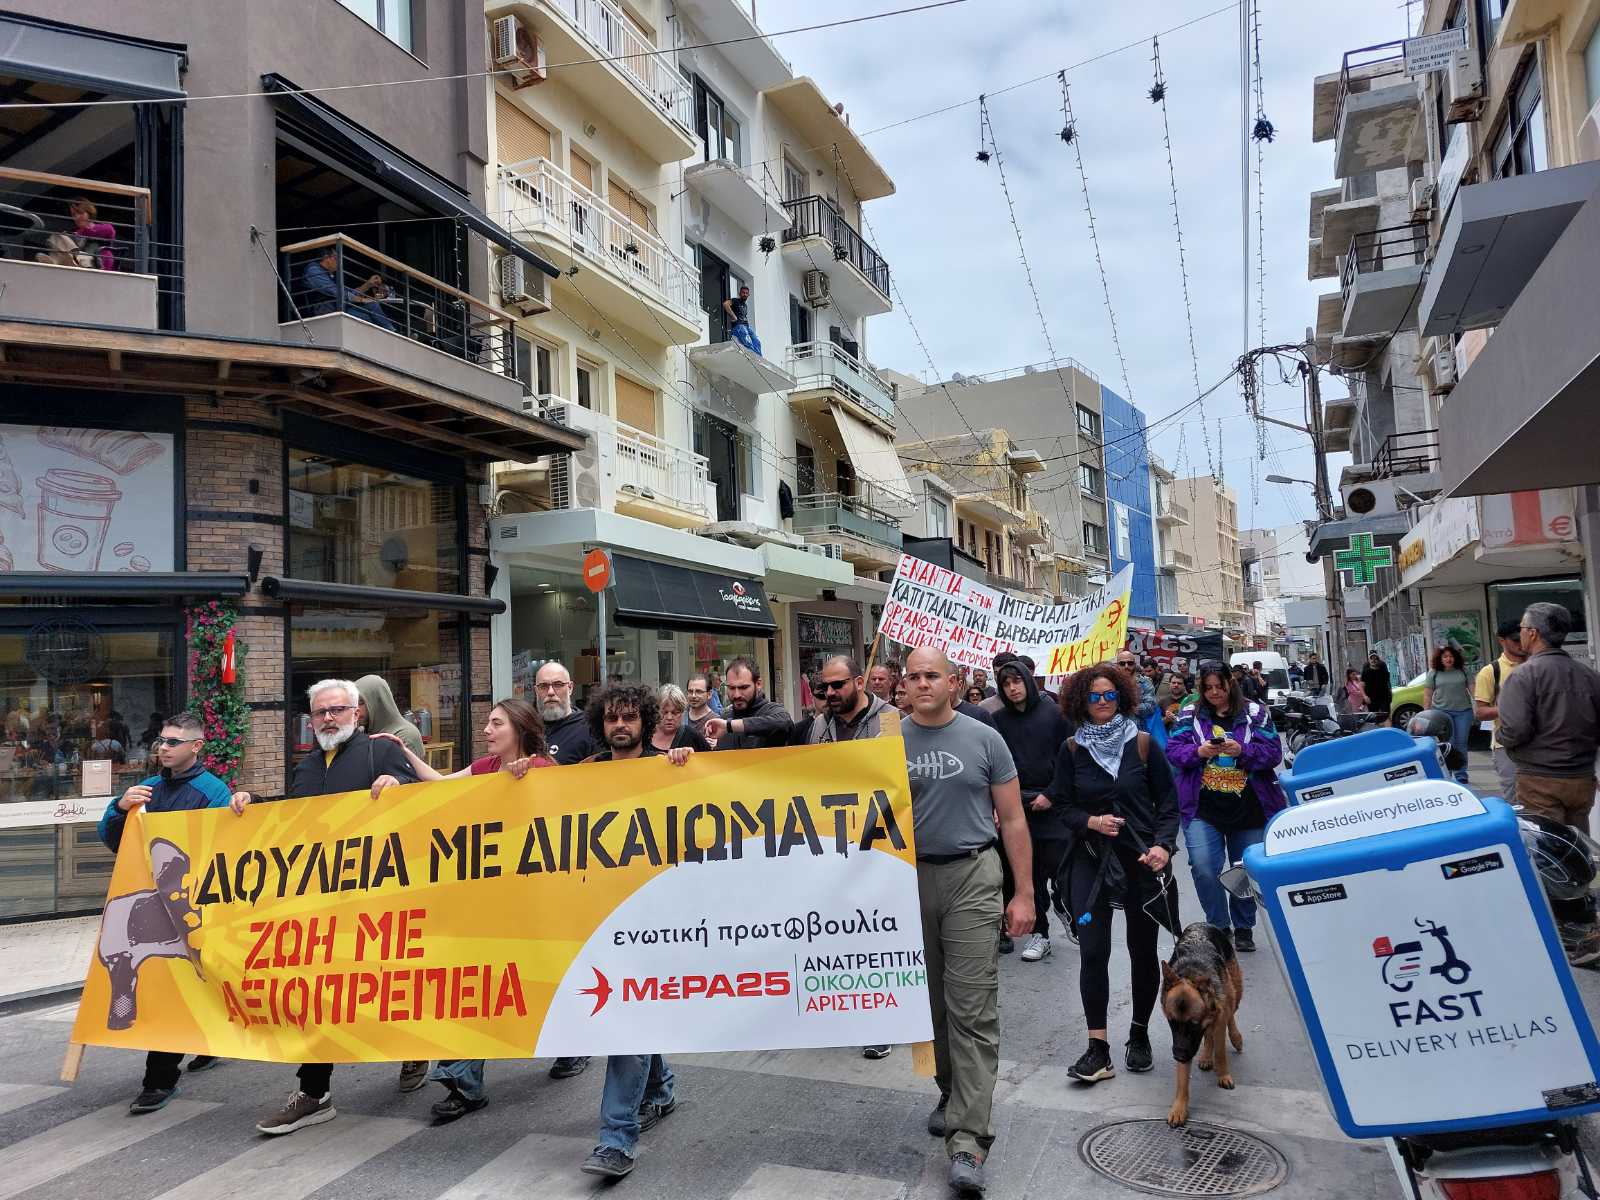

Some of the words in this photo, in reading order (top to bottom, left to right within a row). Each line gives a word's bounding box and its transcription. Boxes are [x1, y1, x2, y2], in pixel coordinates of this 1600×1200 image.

[900, 554, 963, 597] ΕΝΑΝΤΙΑ
[891, 578, 990, 633] ΚΑΠΙΤΑΛΙΣΤΙΚΗ
[1273, 791, 1464, 840] www.fastdeliveryhellas.gr
[195, 832, 410, 906] ΔΟΥΛΕΙΑ
[429, 821, 503, 883] ΜΕ
[515, 789, 908, 876] ΔΙΚΑΙΩΜΑΤΑ
[1460, 862, 1486, 874] Google
[1484, 858, 1500, 869] Play
[1307, 893, 1323, 904] App
[1322, 891, 1342, 900] Store
[244, 915, 337, 970] ΖΩΗ
[354, 908, 427, 962] ΜΕ
[613, 918, 709, 947] ενωτική
[222, 962, 528, 1029] ΑΞΙΟΠΡΕΠΕΙΑ
[804, 969, 927, 993] ΟΙΚΟΛΟΓΙΚΗ
[805, 991, 899, 1013] ΑΡΙΣΤΕΡΑ
[1389, 990, 1483, 1028] FAST
[1346, 1032, 1458, 1060] DELIVERY
[1467, 1016, 1558, 1047] HELLAS
